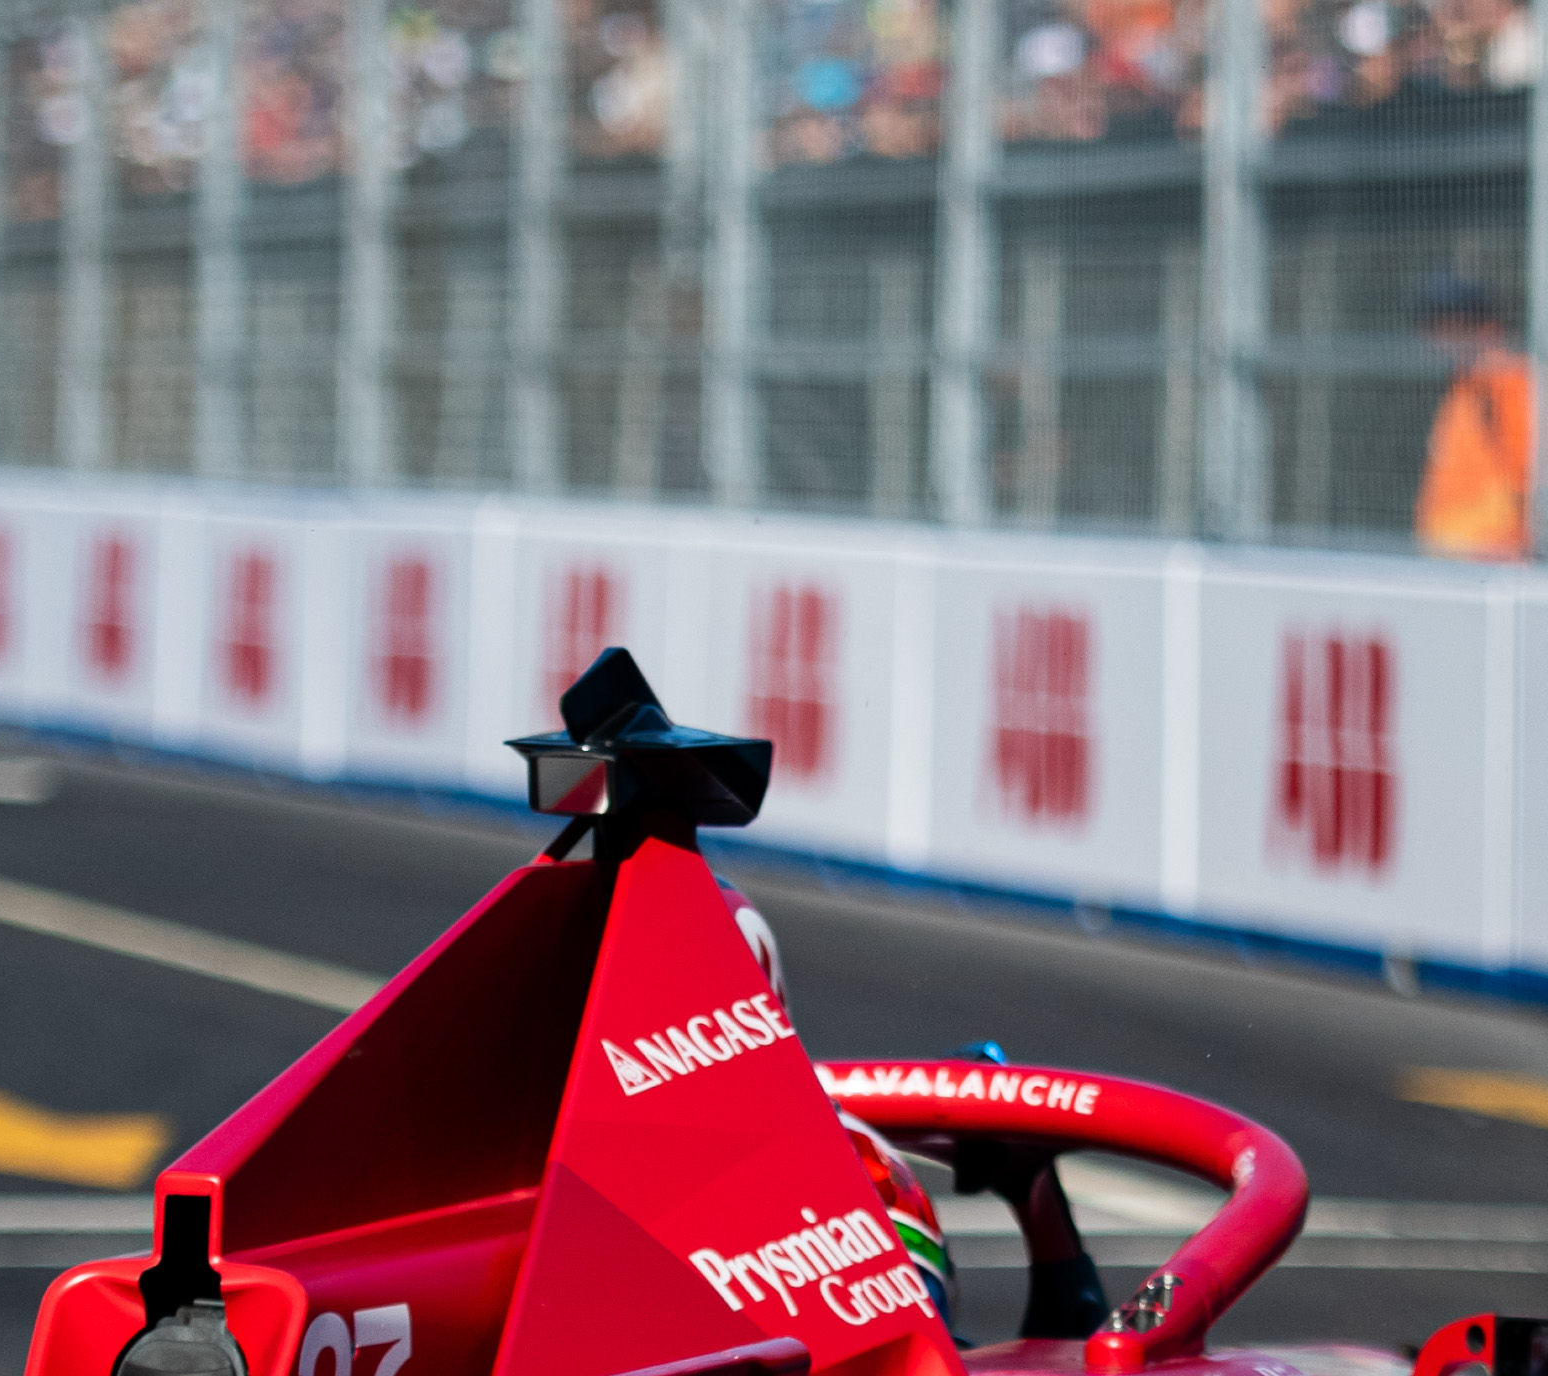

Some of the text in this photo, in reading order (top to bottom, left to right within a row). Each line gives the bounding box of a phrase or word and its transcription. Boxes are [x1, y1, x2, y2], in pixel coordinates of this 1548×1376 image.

[634, 992, 797, 1082] NAGASE
[688, 1206, 895, 1318] Prysmian
[819, 1262, 937, 1326] Group
